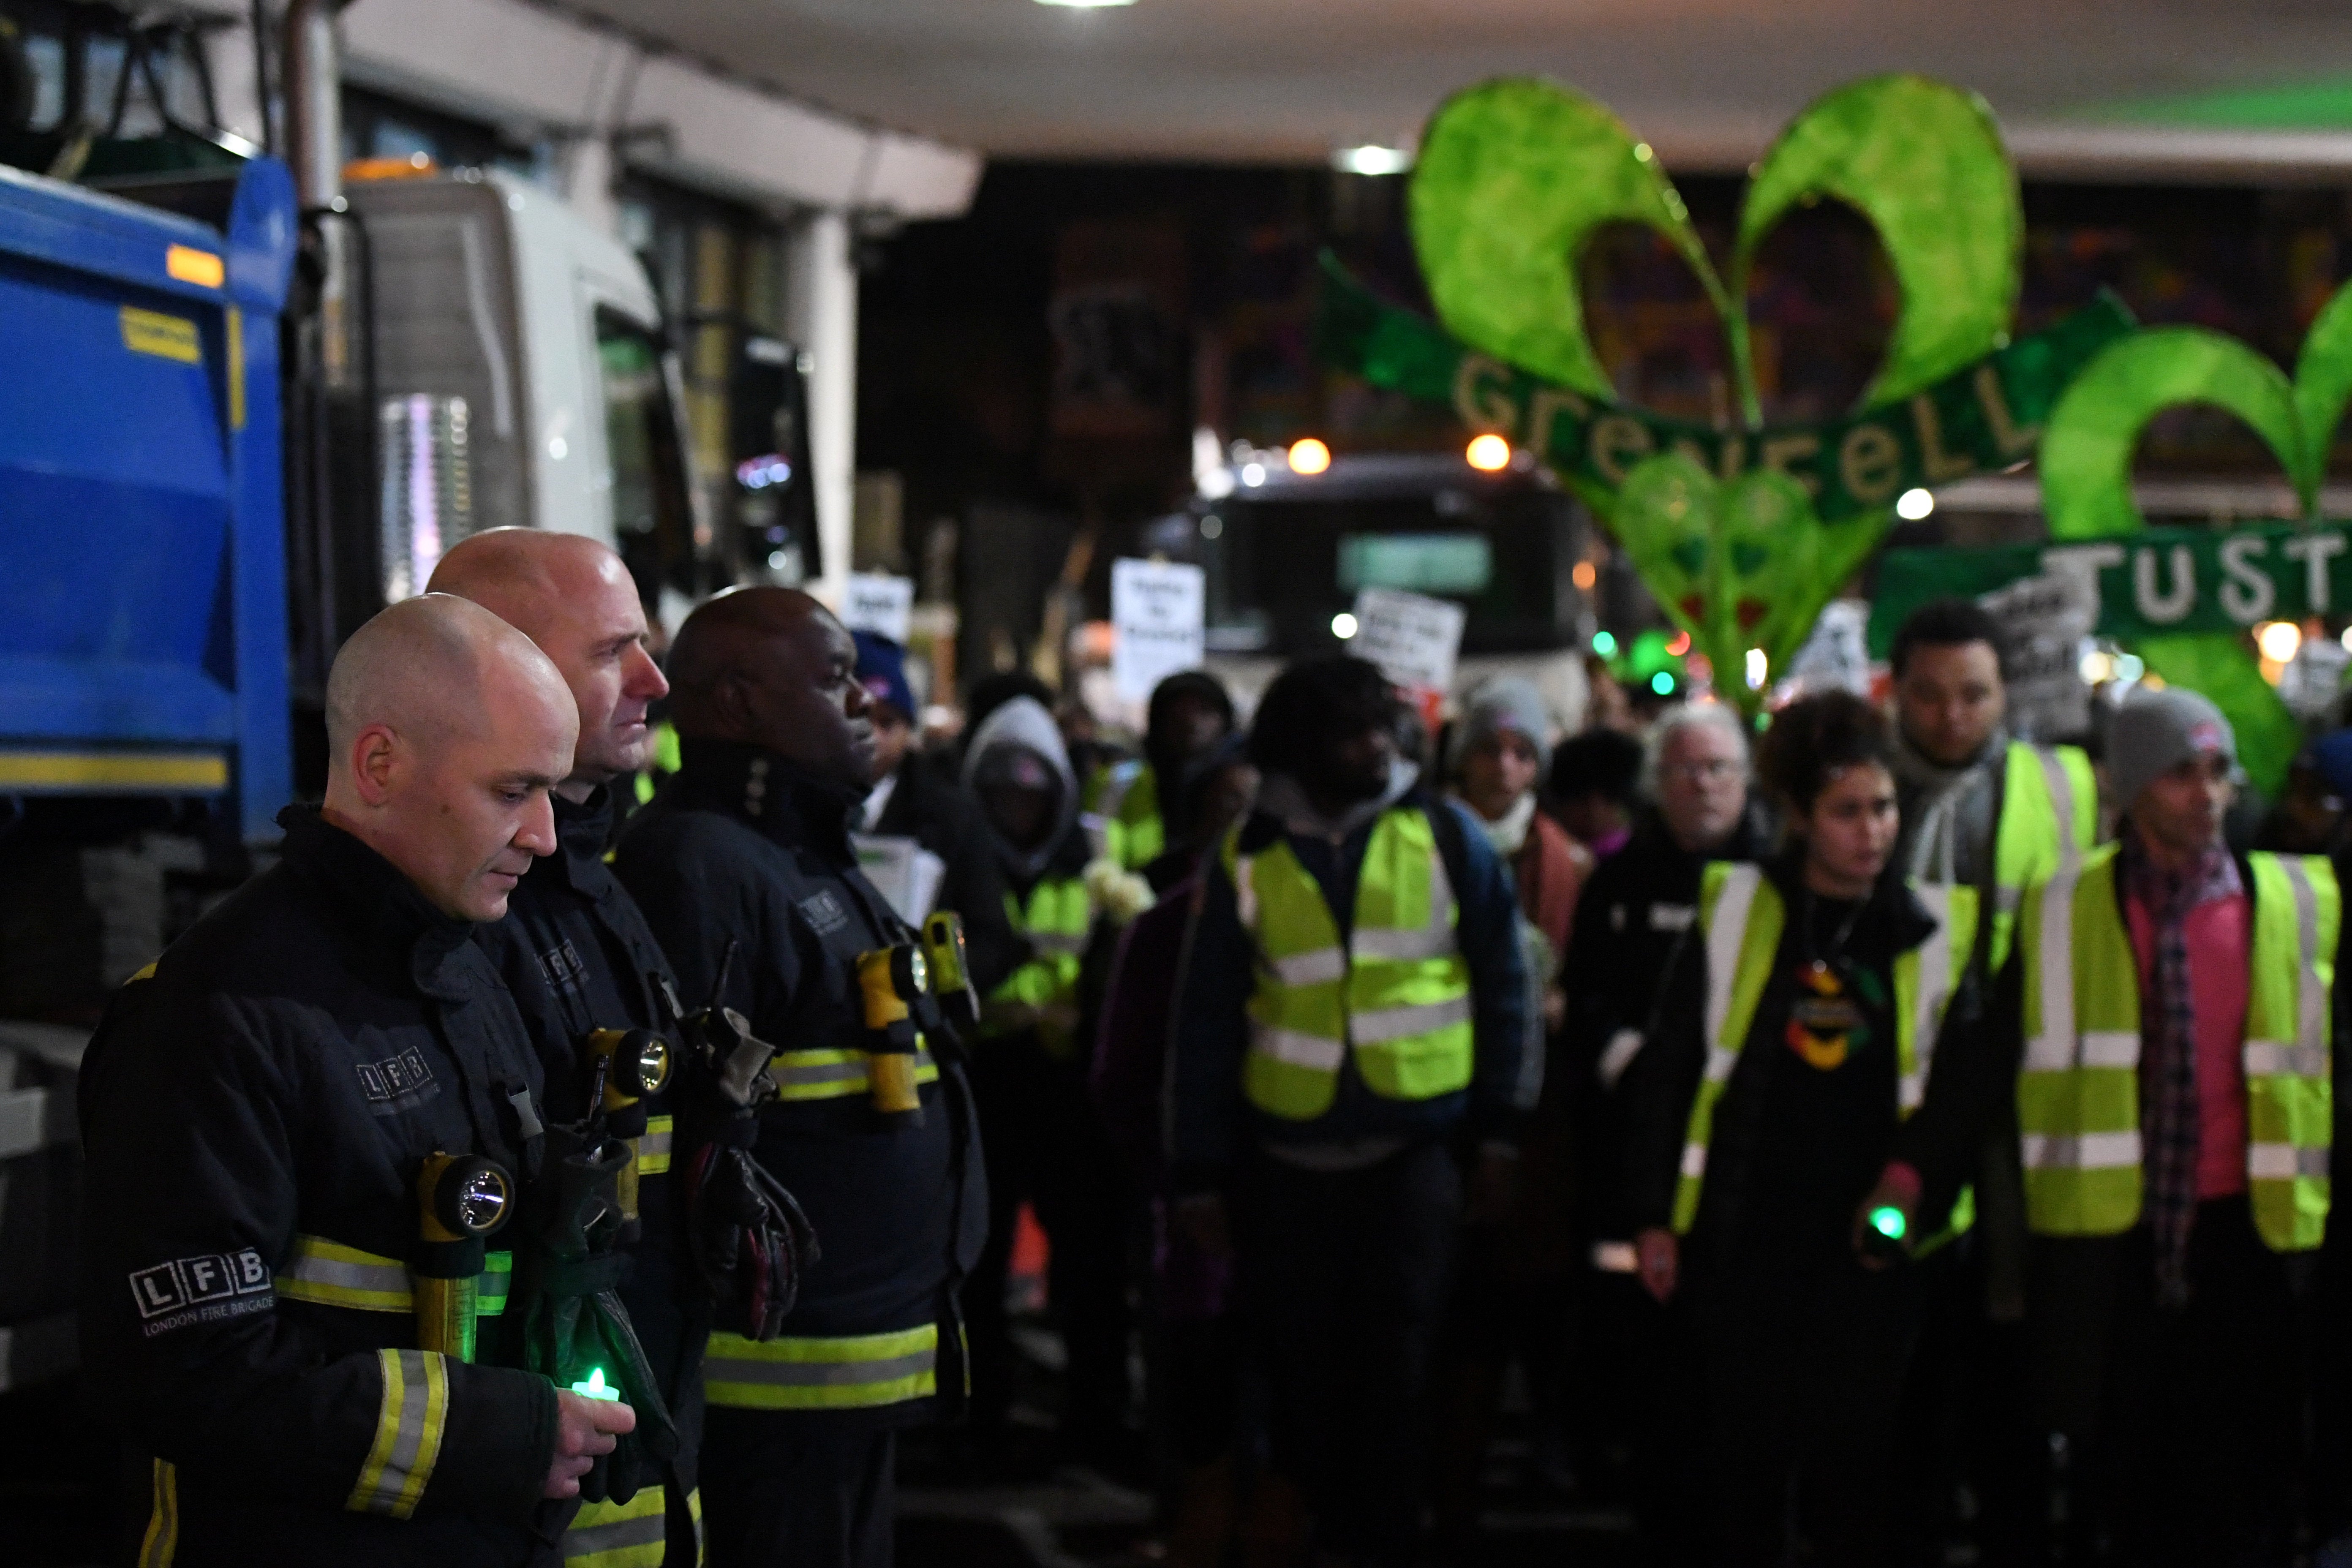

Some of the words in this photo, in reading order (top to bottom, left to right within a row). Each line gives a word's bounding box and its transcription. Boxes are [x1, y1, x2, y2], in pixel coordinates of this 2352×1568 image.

[362, 1053, 425, 1094] LFB
[142, 1250, 264, 1307] LFB
[144, 1312, 197, 1337] LONDON
[201, 1305, 228, 1321] FIRE
[230, 1296, 274, 1315] BRIGADE
